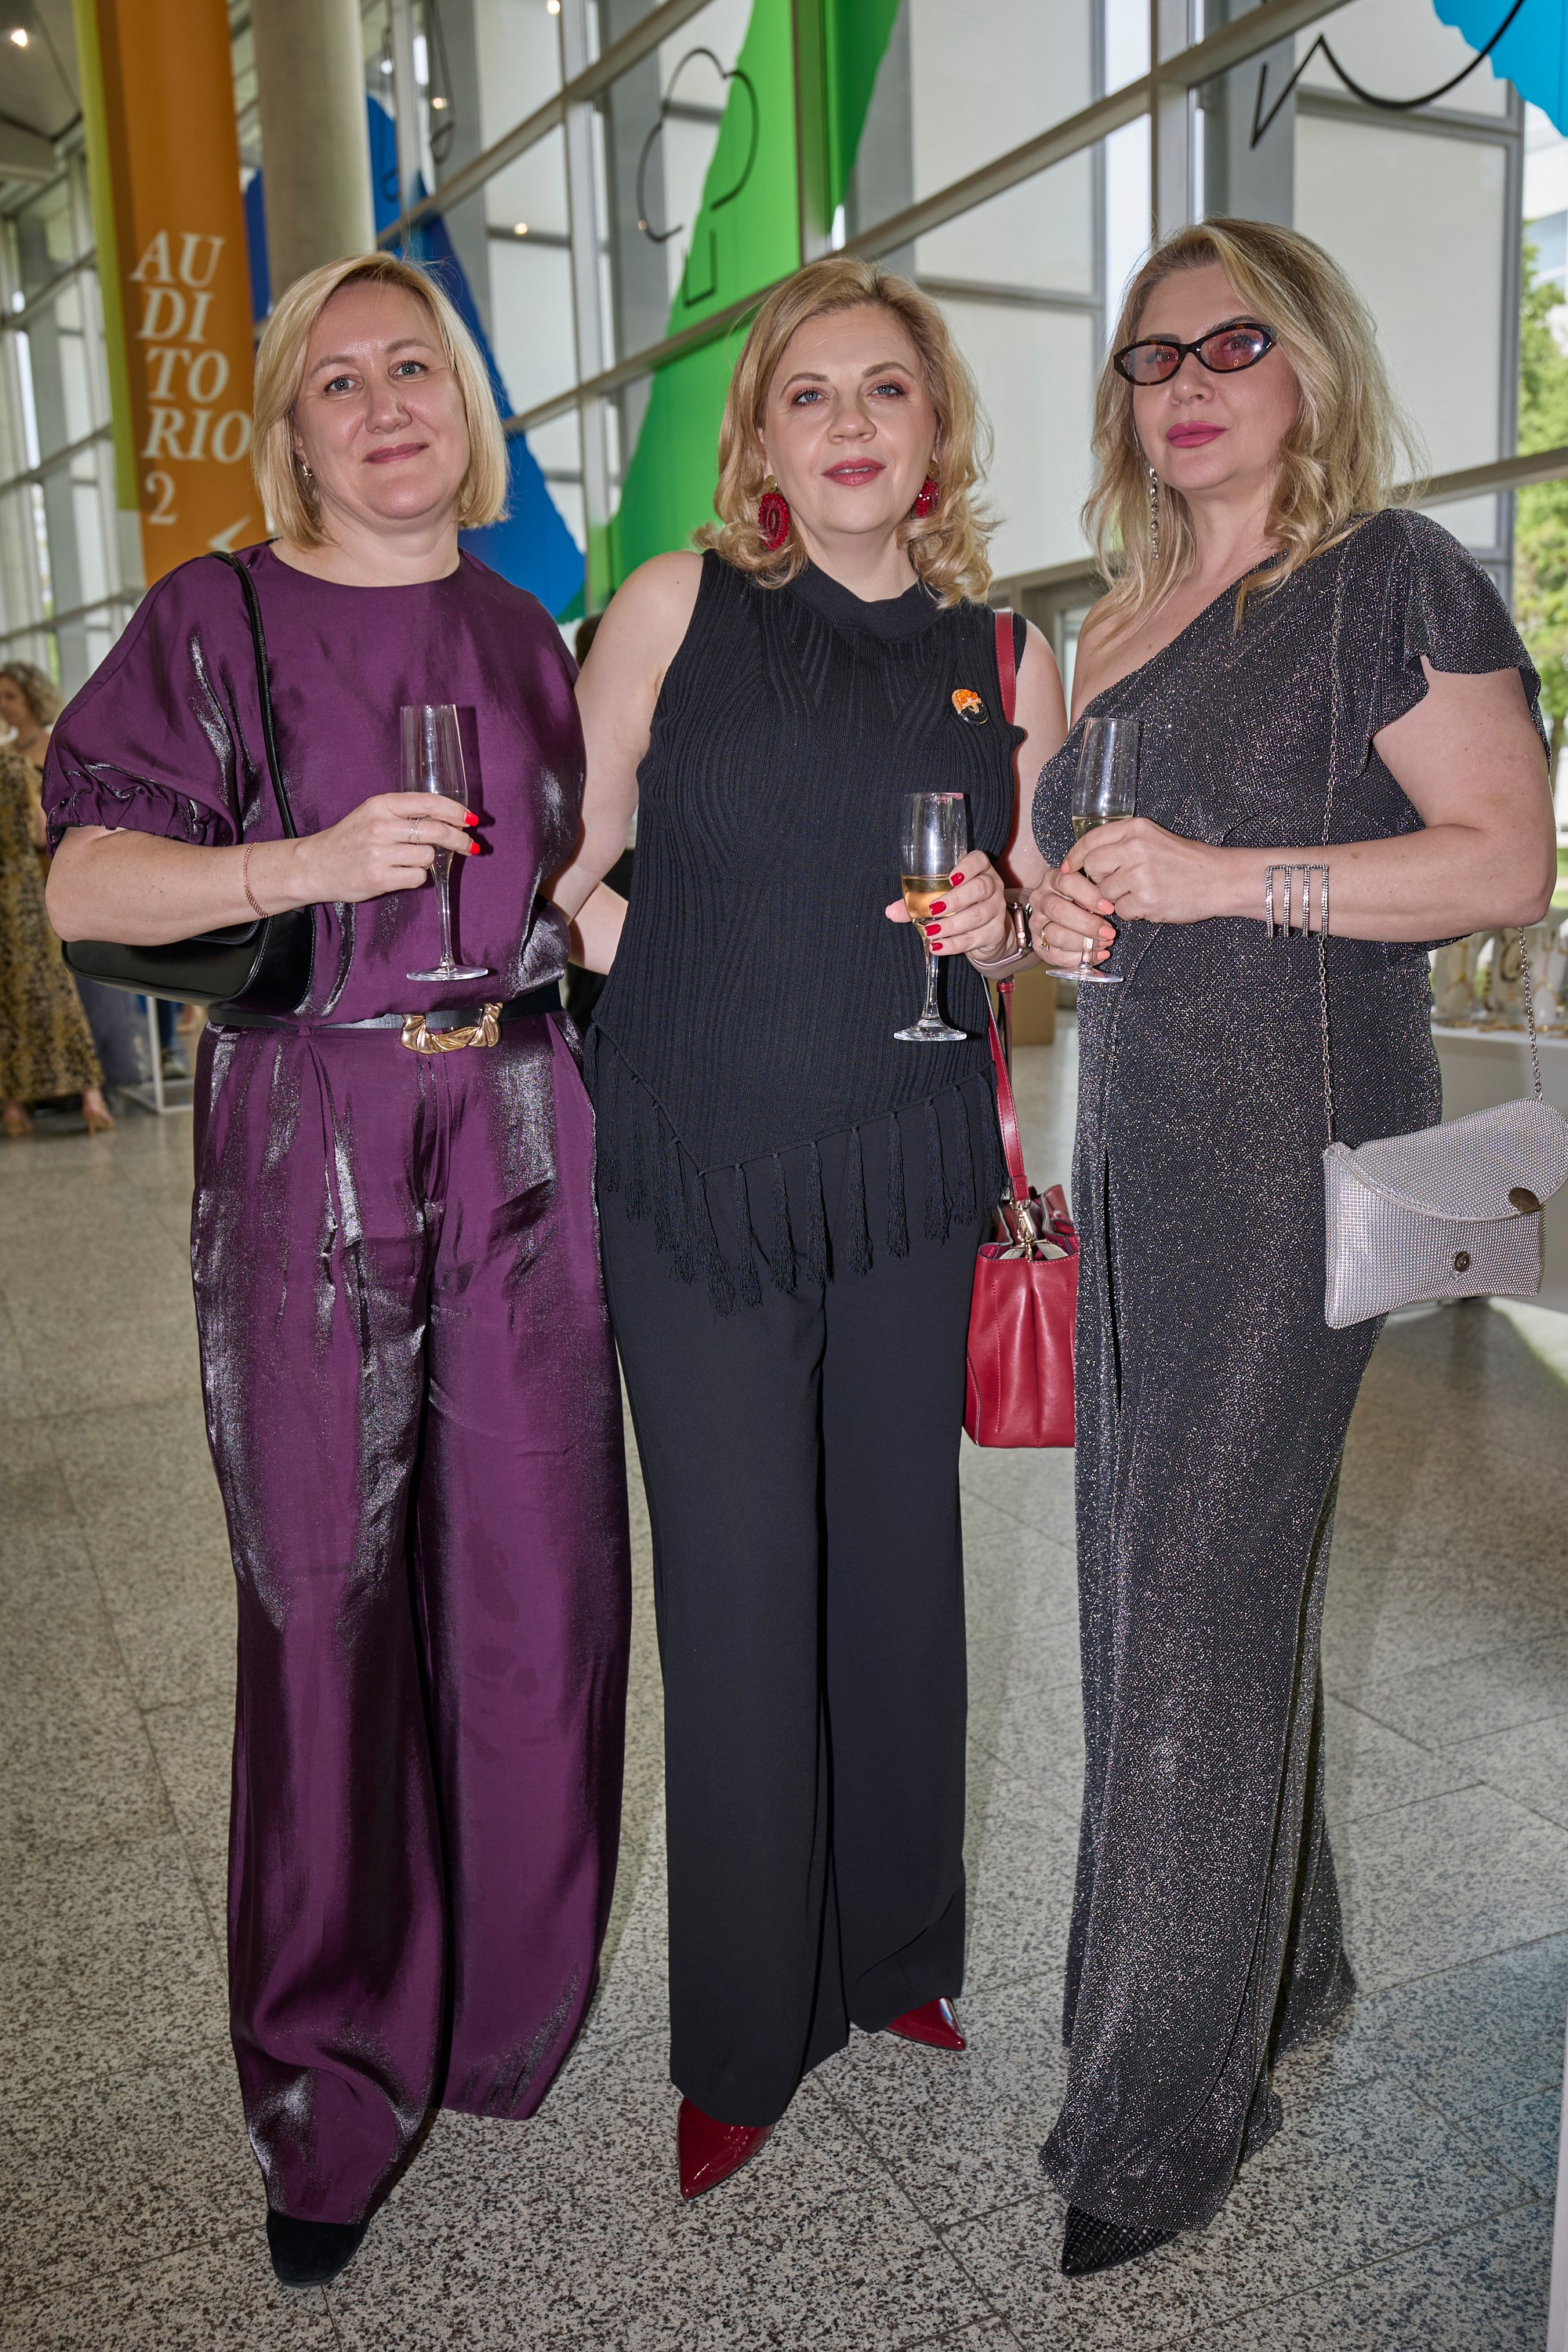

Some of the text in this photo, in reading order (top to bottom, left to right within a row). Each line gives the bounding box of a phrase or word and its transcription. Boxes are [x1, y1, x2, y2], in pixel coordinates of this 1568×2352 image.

[129, 230, 225, 288] AU
[137, 287, 214, 343] DI
[146, 347, 229, 404] TO
[141, 405, 252, 464] RIO
[145, 470, 177, 524] 2
